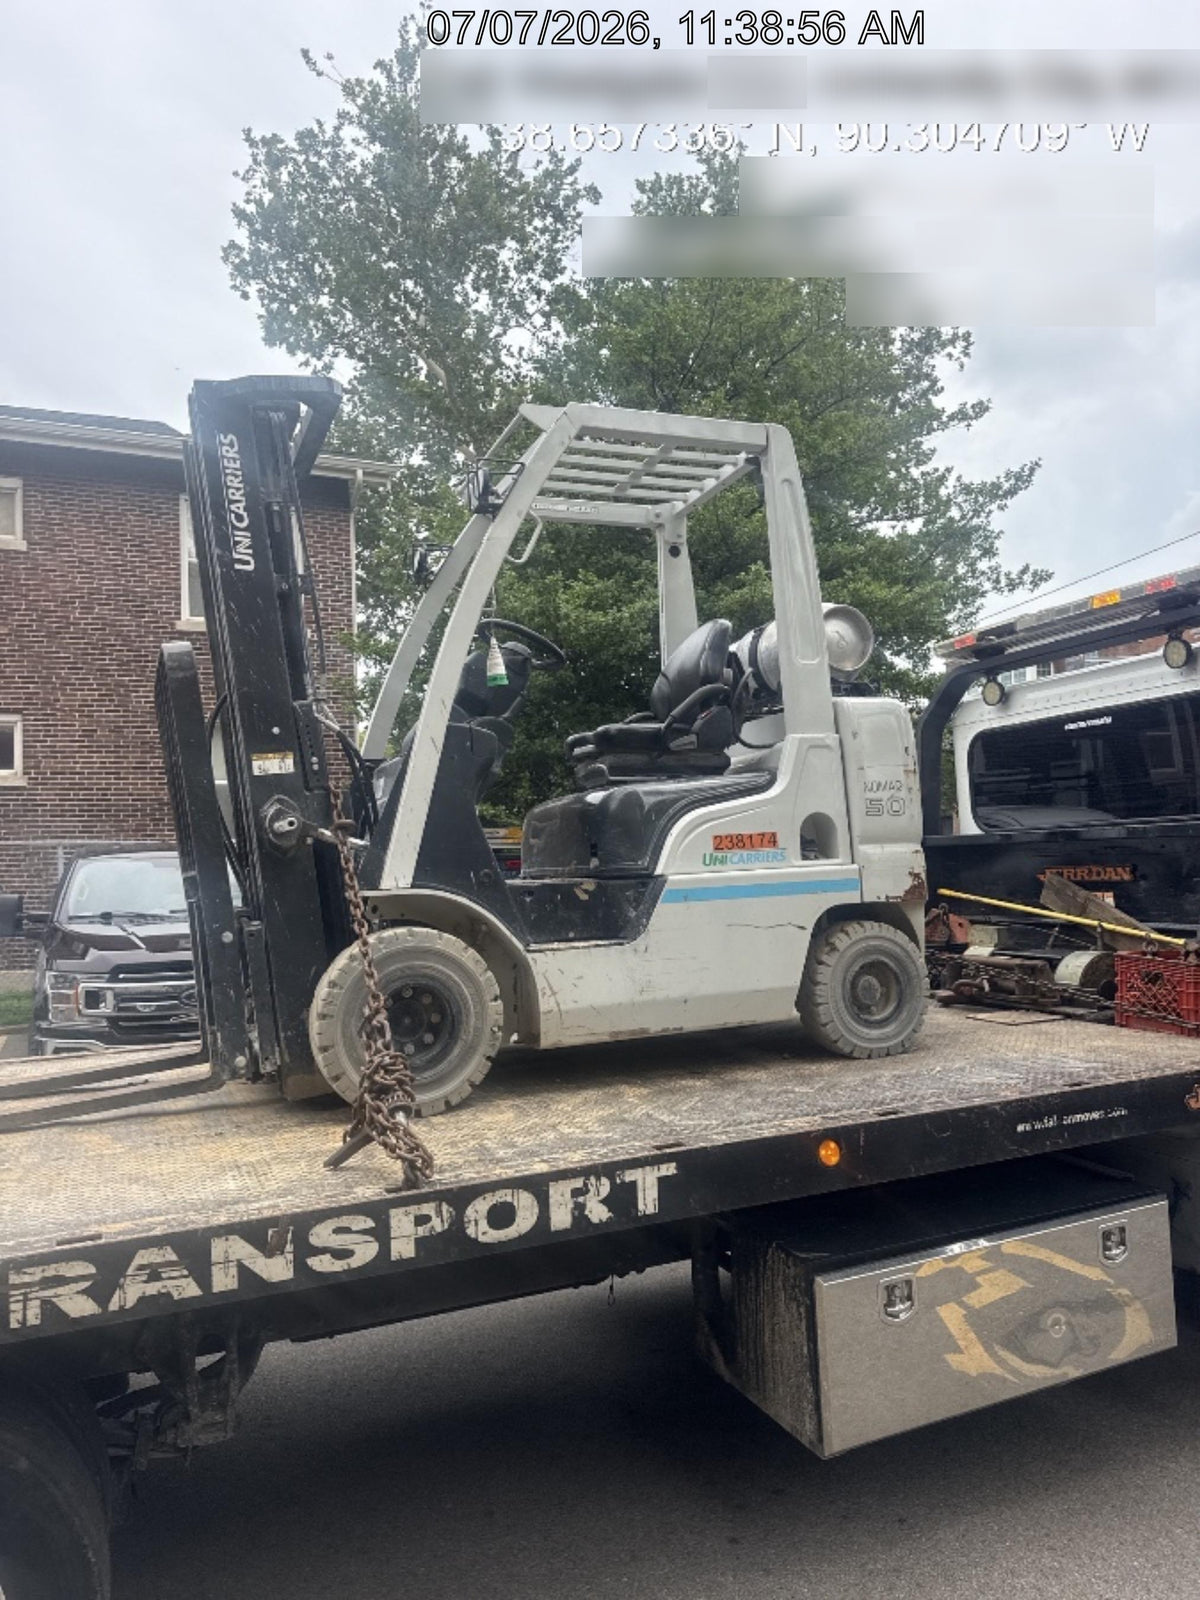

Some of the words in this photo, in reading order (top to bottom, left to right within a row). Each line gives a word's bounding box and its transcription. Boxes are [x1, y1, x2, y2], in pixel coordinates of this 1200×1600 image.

[865, 797, 906, 817] 50
[713, 832, 778, 850] 238174
[8, 1161, 678, 1329] RANSPORT
